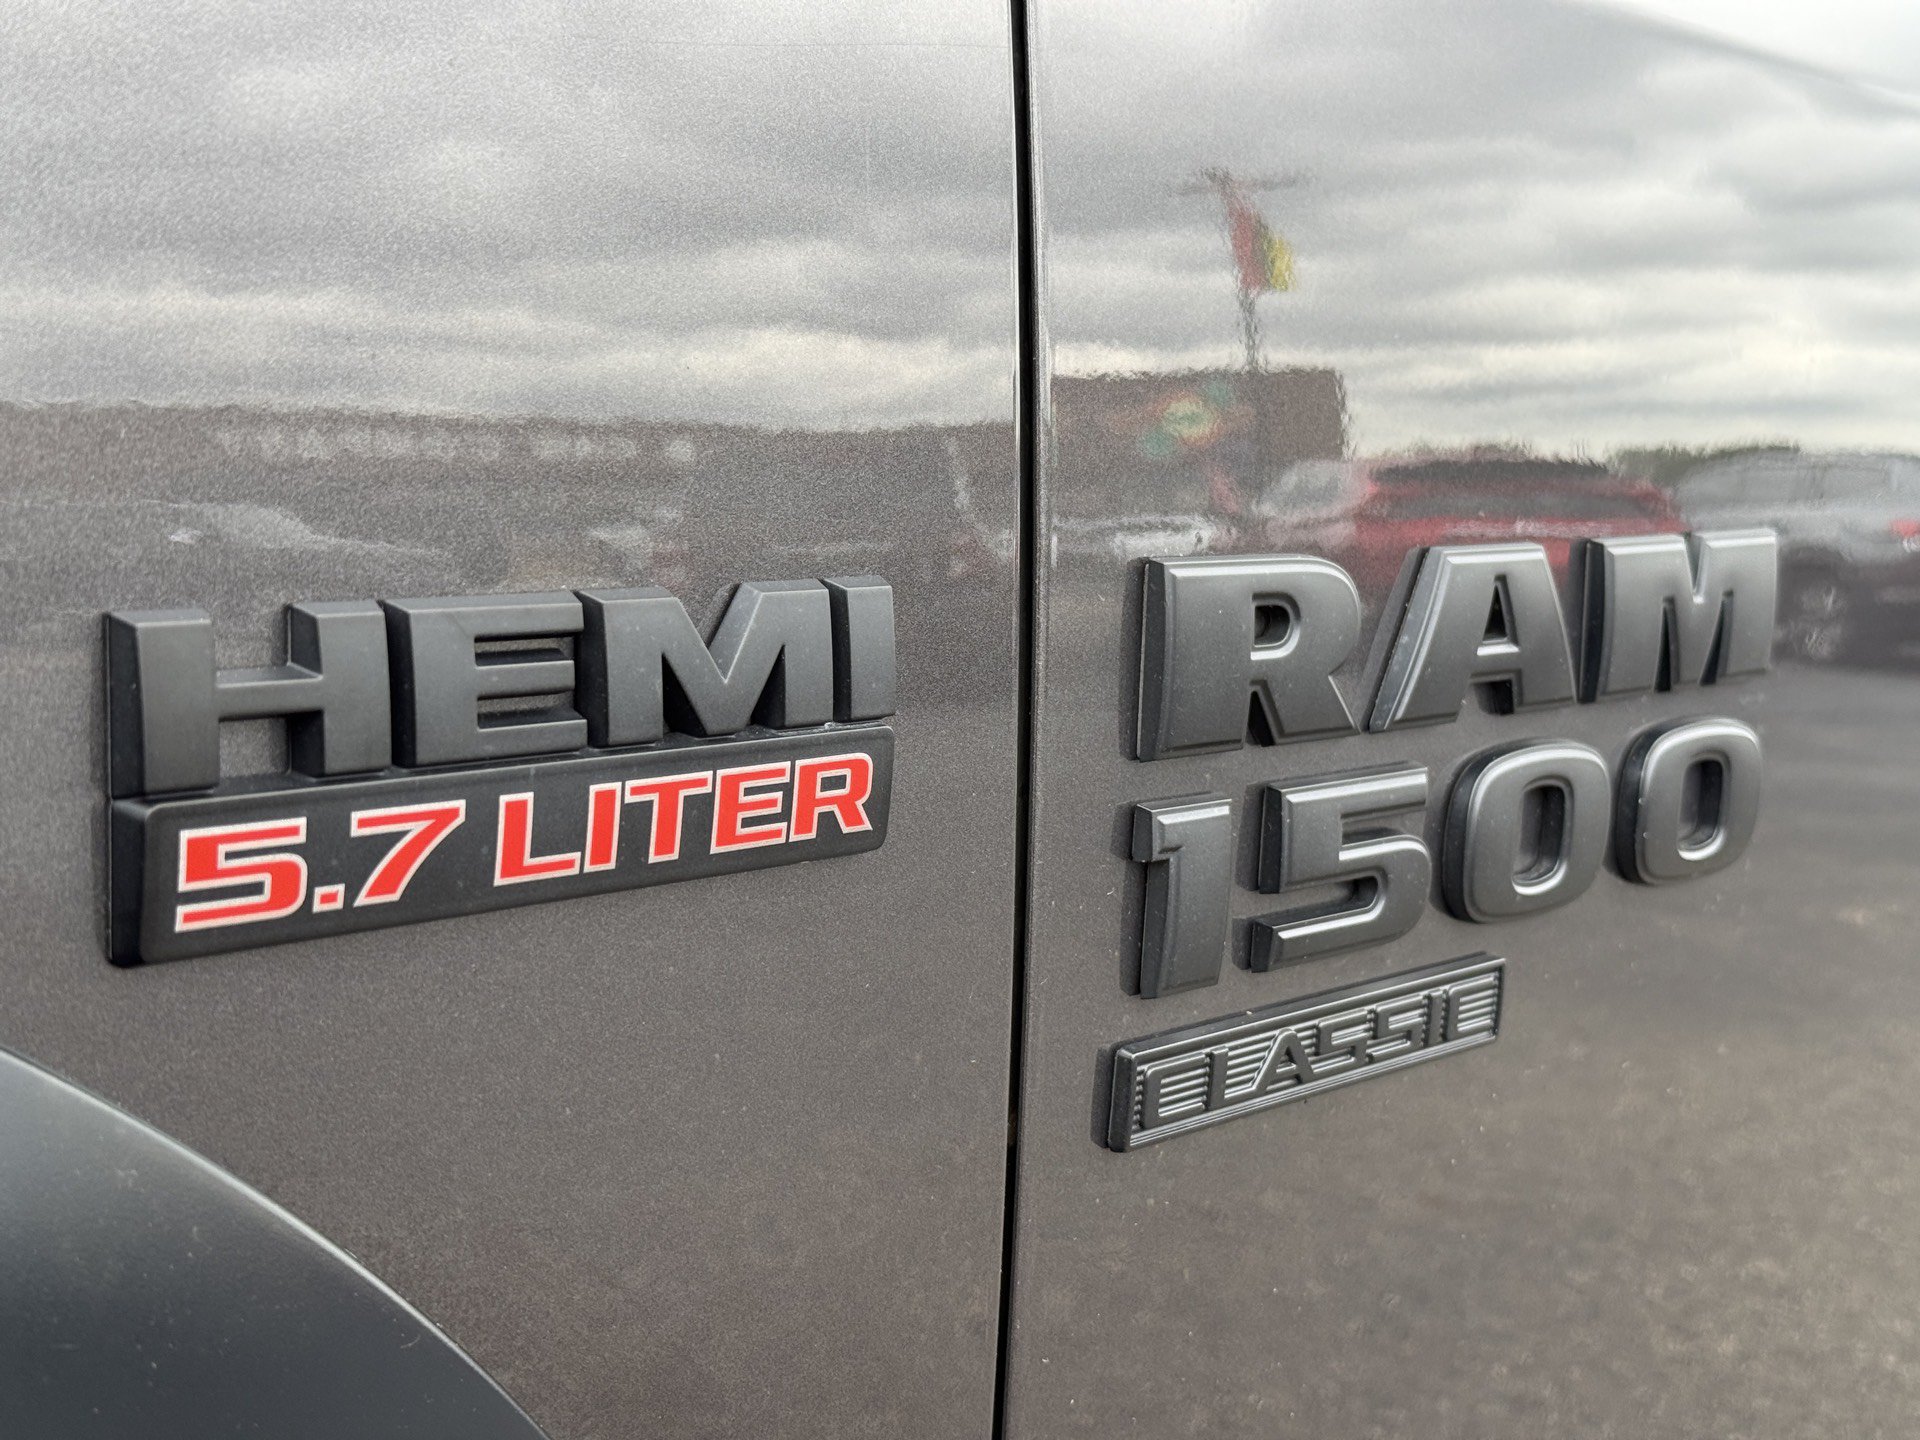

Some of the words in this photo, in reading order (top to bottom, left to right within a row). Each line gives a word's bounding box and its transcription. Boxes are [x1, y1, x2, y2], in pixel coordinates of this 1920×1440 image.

[106, 574, 895, 797] HEMI
[1138, 528, 1777, 762] RAM
[174, 800, 466, 934] 5.7
[493, 751, 874, 887] LITER
[1132, 717, 1763, 999] 1500
[1142, 974, 1497, 1130] CLASSIC
